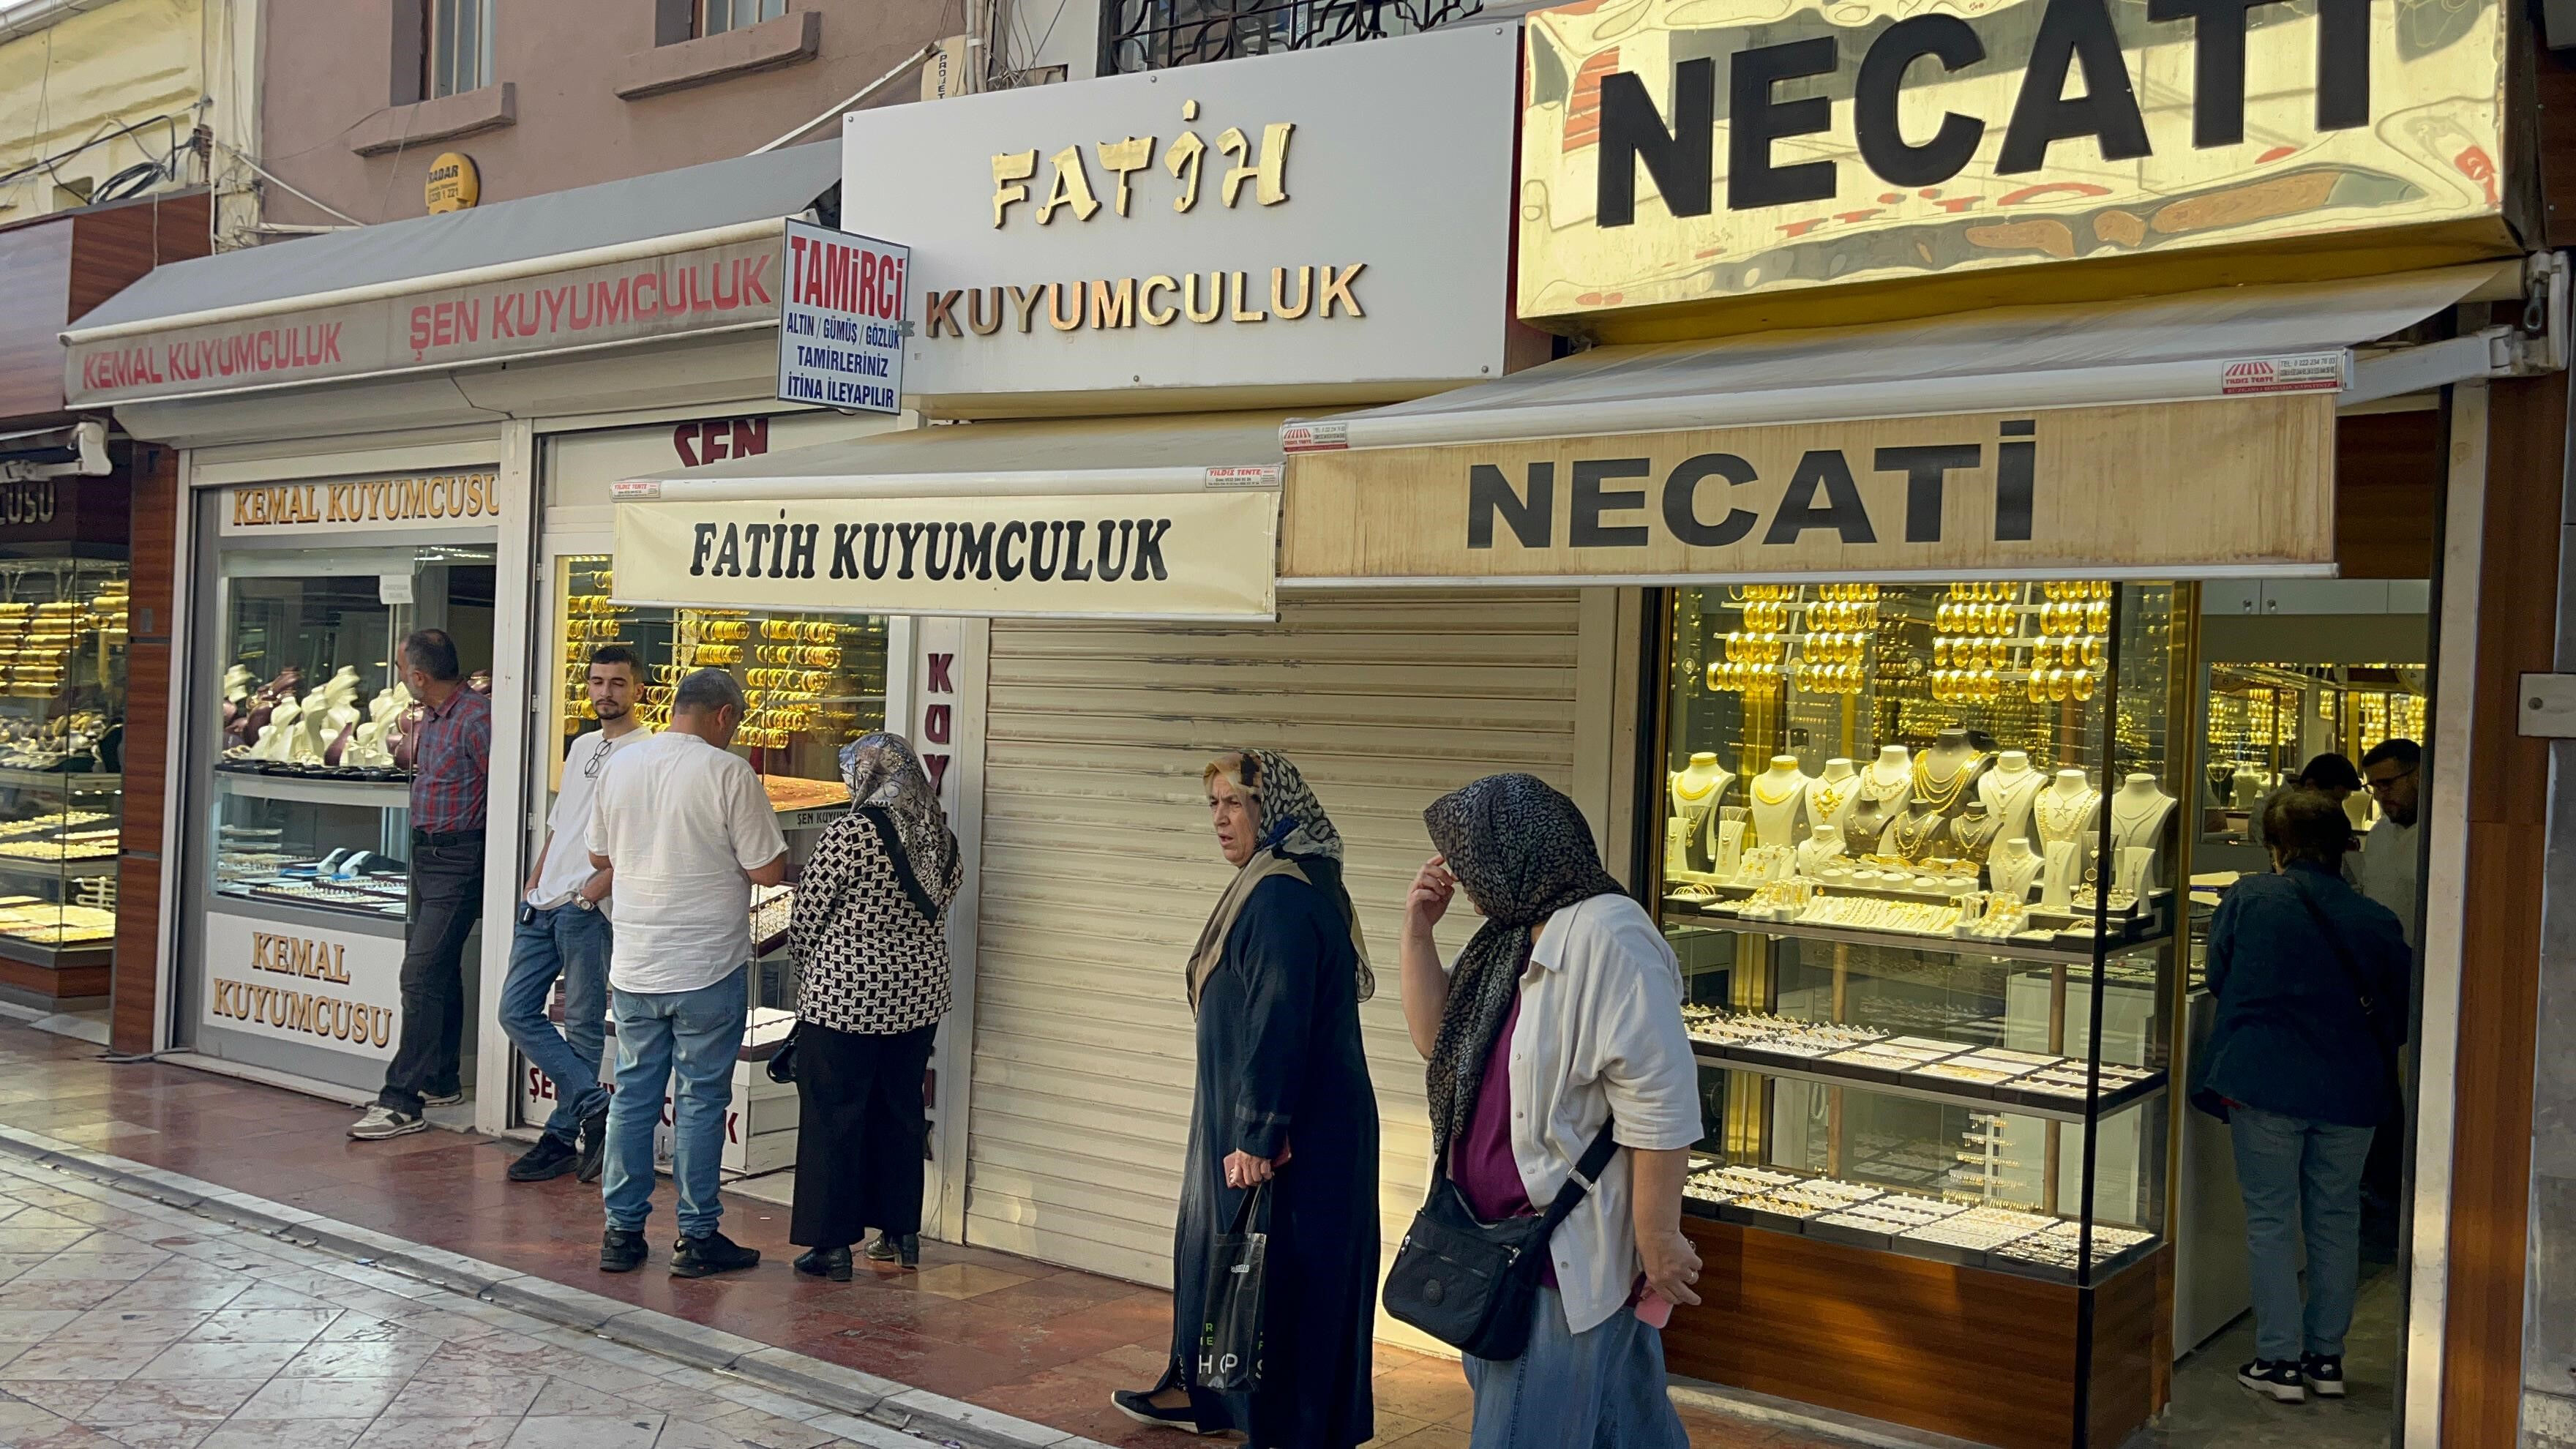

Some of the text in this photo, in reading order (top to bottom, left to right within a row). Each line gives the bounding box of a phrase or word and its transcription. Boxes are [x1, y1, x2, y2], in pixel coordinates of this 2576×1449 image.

[991, 99, 1296, 230] FATİH
[410, 254, 772, 362] ŞEN KUYUMCULUK
[926, 263, 1368, 338] KUYUMCULUK
[83, 322, 343, 389] KEMAL KUYUMCULUK
[787, 312, 815, 337] ALTIN
[823, 315, 858, 345] GÜMÜŞ
[865, 322, 900, 350] GÖZLÜK
[787, 371, 823, 400] İTİNA
[797, 345, 888, 378] TAMİRLERİNİZ
[233, 484, 320, 526] KEMAL
[1467, 419, 2036, 550] NECATİ
[689, 508, 1172, 583] FATİH KUYUMCULUK
[797, 812, 813, 827] ŞEN
[252, 932, 351, 985] KEMAL
[212, 977, 393, 1048] KUYUMCUSU
[529, 1067, 561, 1103] ŞE
